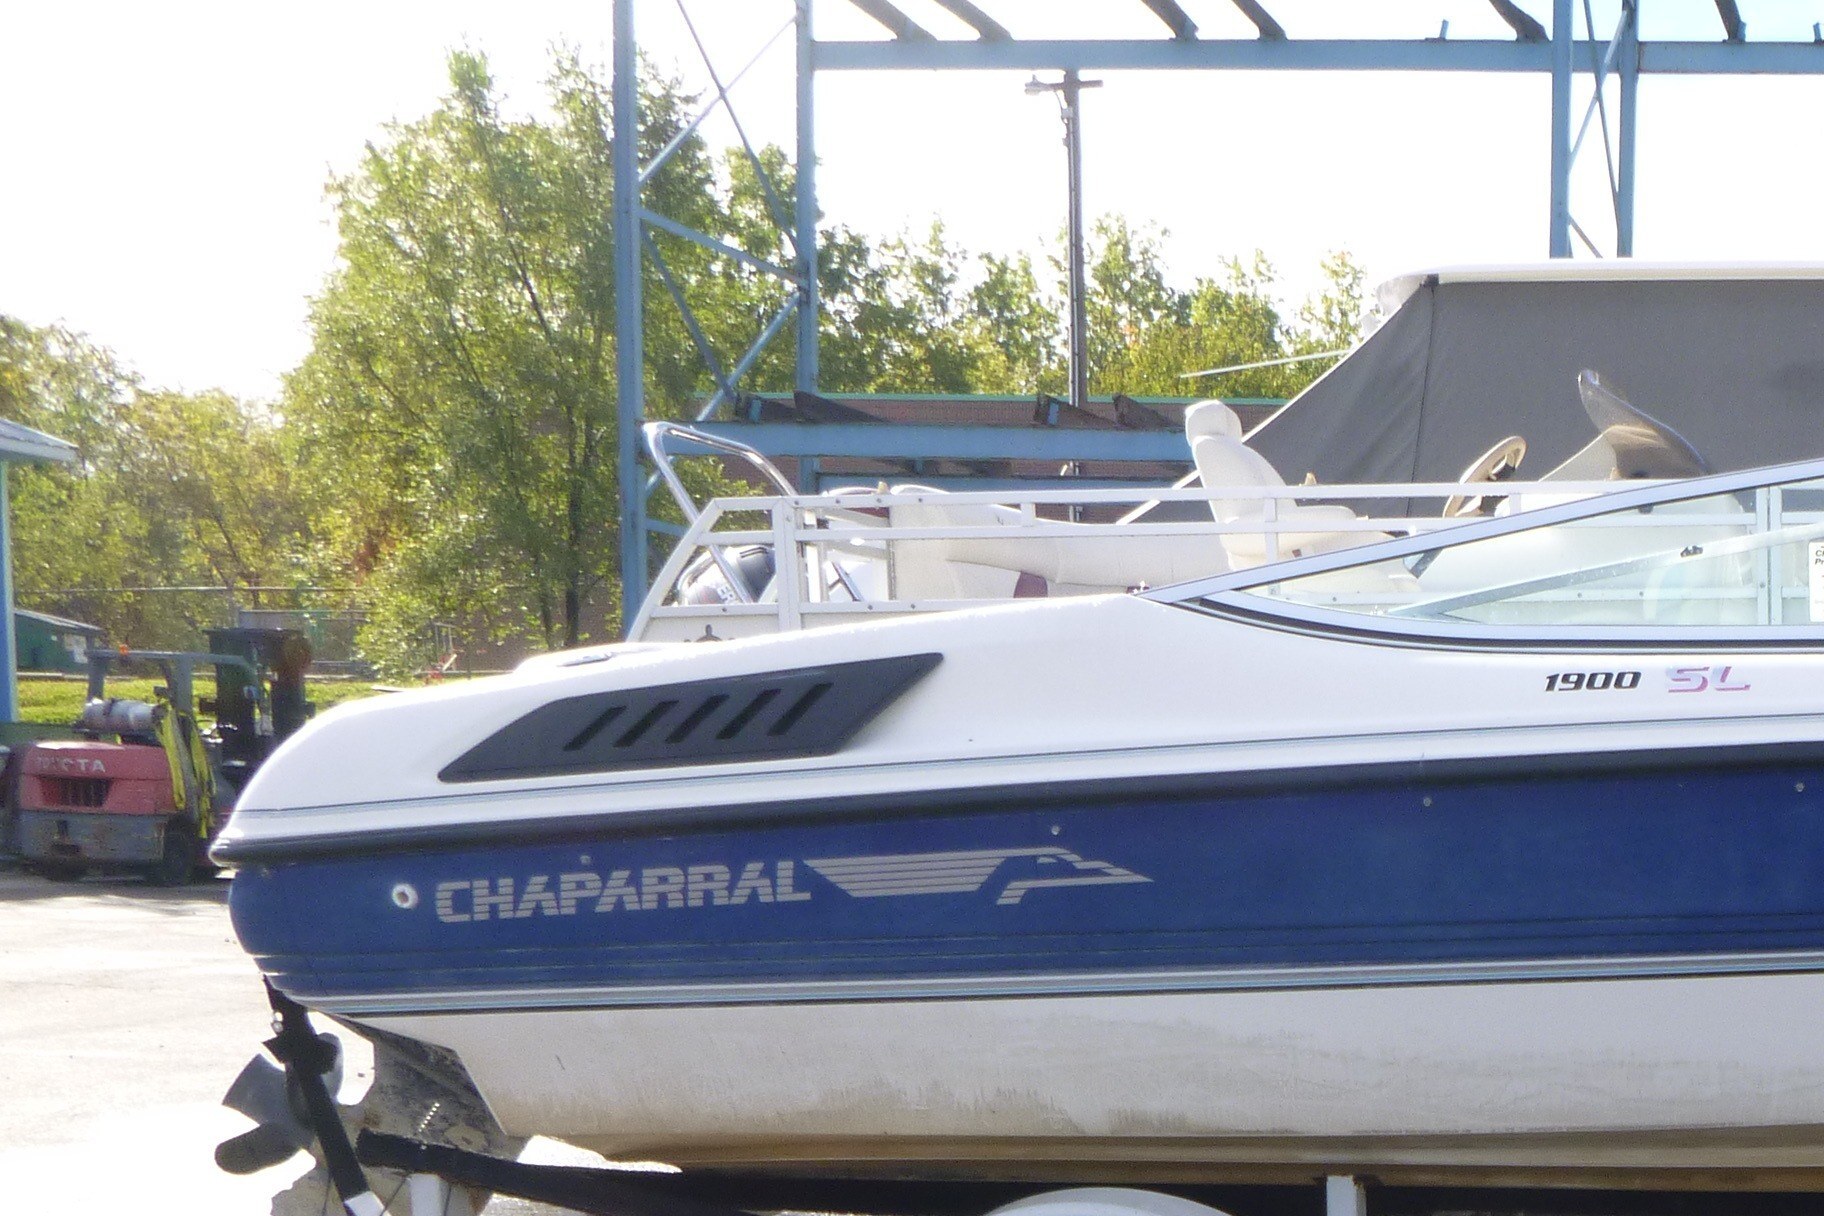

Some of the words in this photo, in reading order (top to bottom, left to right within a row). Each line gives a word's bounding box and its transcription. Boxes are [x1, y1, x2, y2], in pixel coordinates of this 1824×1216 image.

[1545, 670, 1641, 692] 1900
[1665, 665, 1751, 693] SL
[434, 859, 812, 924] CHAPARRAL
